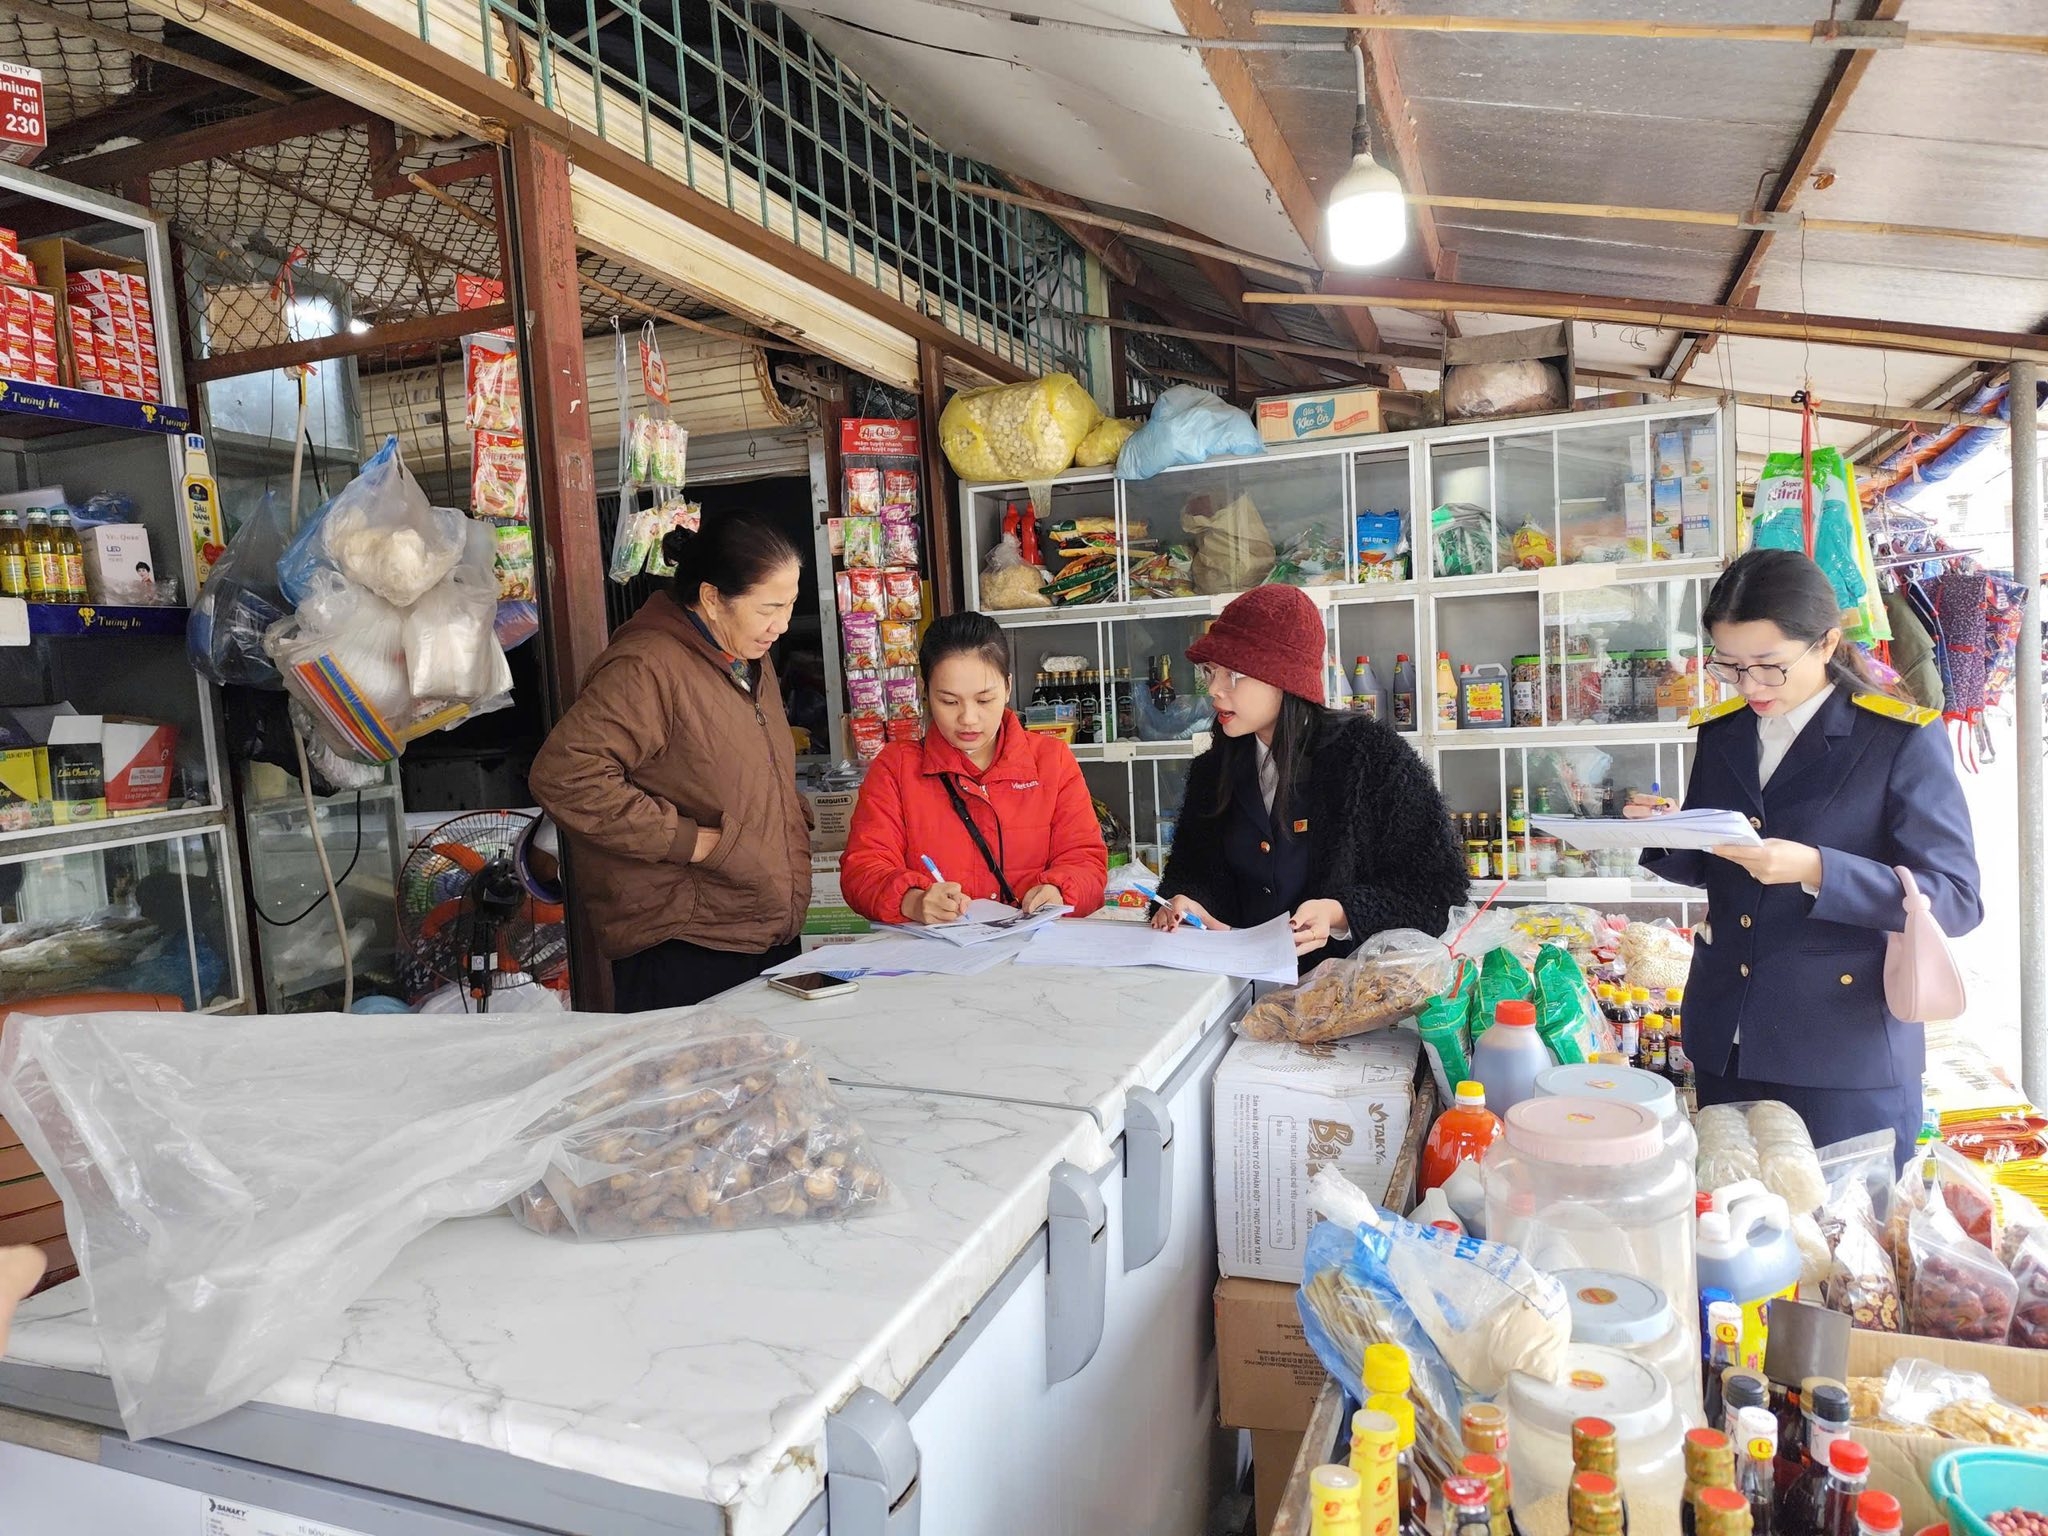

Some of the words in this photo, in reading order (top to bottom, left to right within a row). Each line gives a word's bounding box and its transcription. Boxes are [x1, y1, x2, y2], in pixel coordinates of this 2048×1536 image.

[2, 63, 32, 76] DUTY
[13, 97, 39, 115] Foil
[5, 113, 40, 136] 230
[1781, 480, 1802, 488] Super
[1252, 1150, 1260, 1159] TY
[217, 1504, 246, 1517] SANAKY
